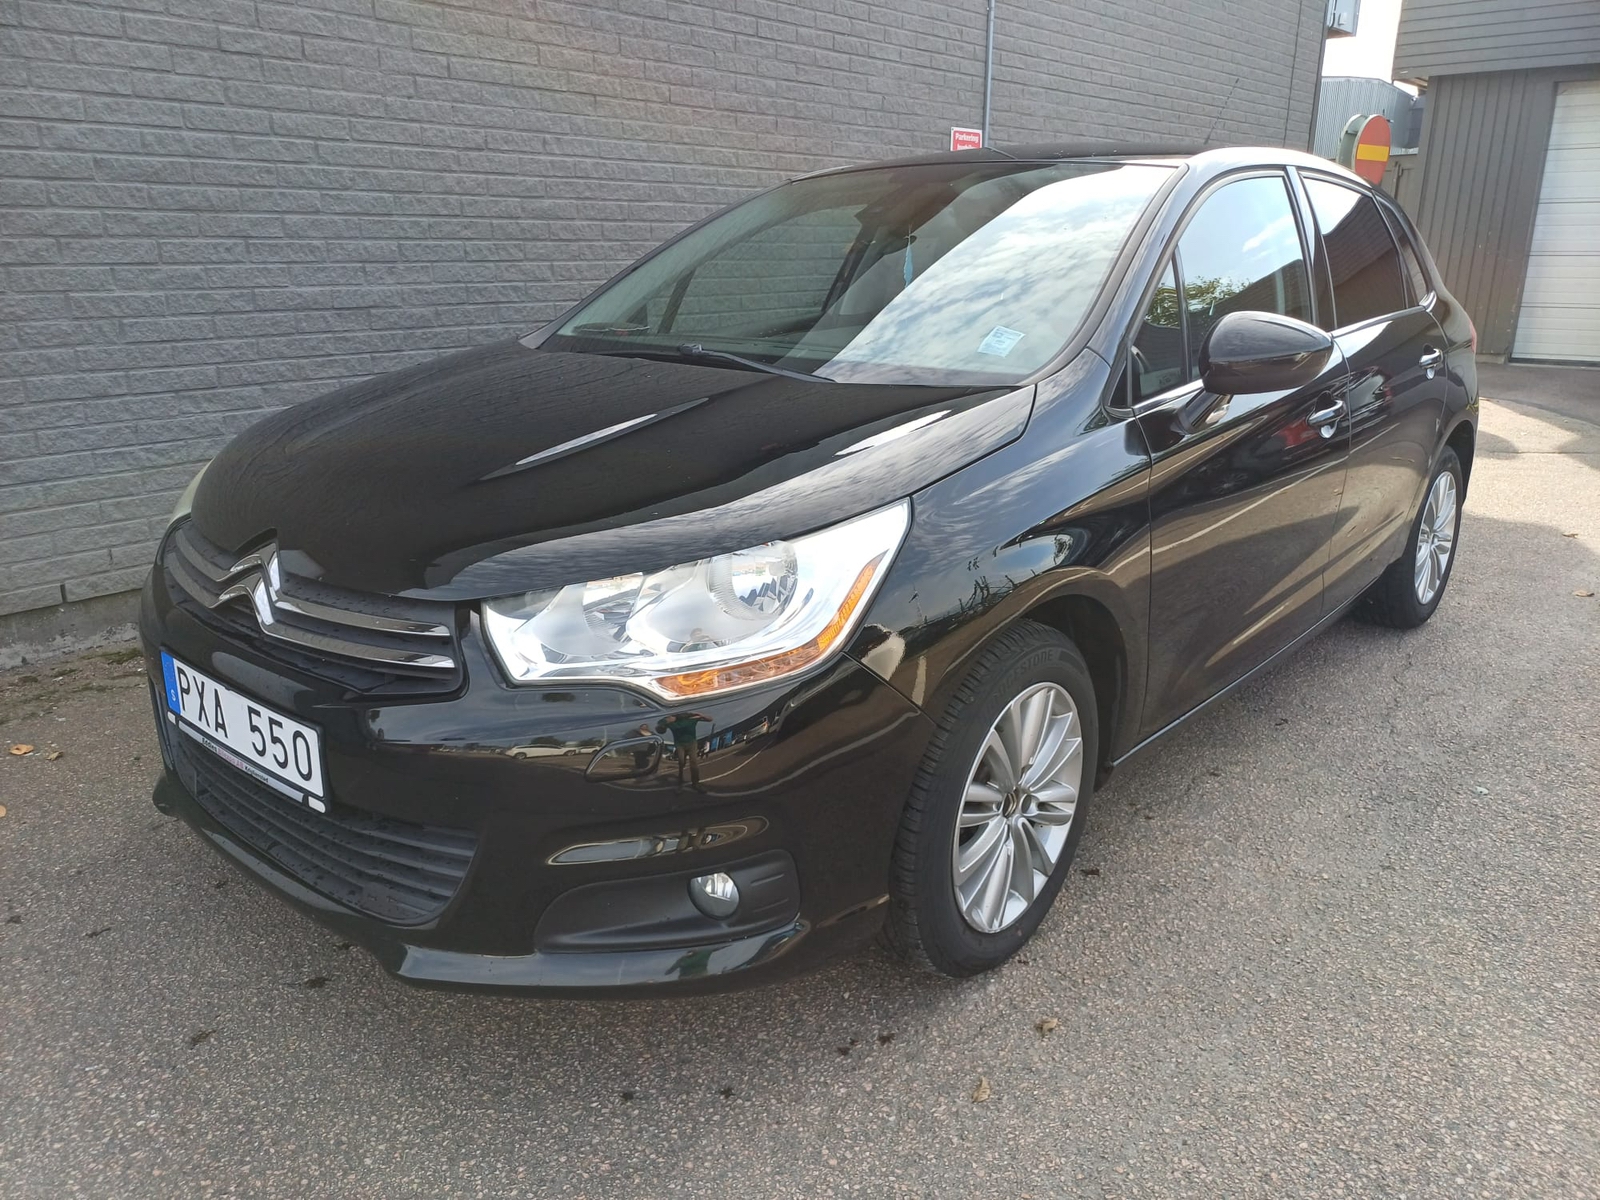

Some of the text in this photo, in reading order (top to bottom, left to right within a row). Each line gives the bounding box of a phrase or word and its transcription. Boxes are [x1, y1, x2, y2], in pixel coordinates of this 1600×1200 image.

[955, 132, 979, 143] Parkering
[170, 688, 176, 702] S
[176, 665, 229, 739] PXA
[247, 705, 313, 781] 550
